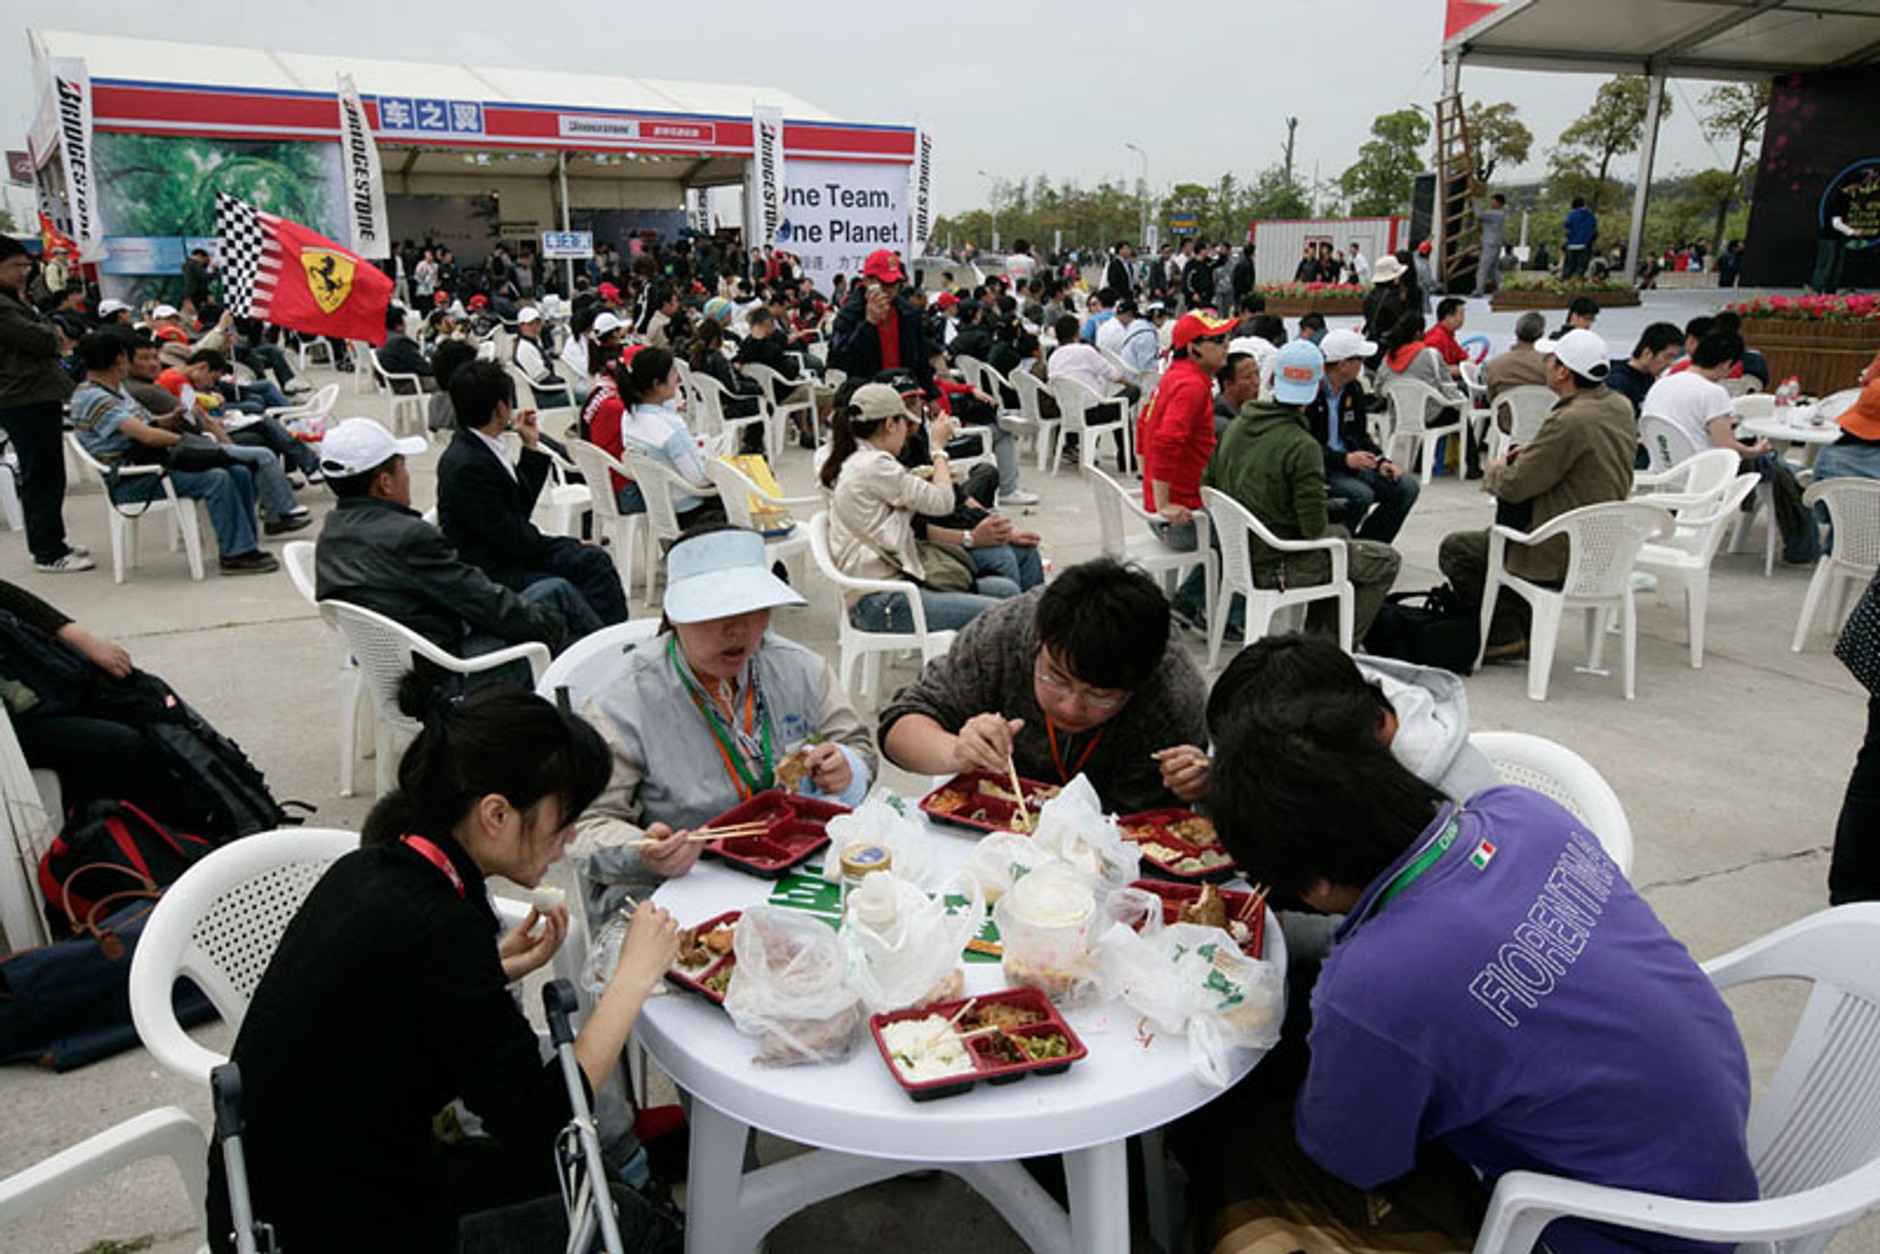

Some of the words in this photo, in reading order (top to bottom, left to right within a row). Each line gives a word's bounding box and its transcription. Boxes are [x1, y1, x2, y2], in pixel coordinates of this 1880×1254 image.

[55, 75, 91, 242] BRIDGESTONE
[342, 97, 375, 242] BRIDGESTONE
[383, 99, 479, 131] 车之翼
[760, 121, 778, 241] BRIDGESTON
[825, 183, 897, 211] Team,
[829, 219, 904, 244] Planet.
[917, 131, 932, 242] BRIDGESTONE
[1468, 831, 1615, 1028] FIORENTINA
